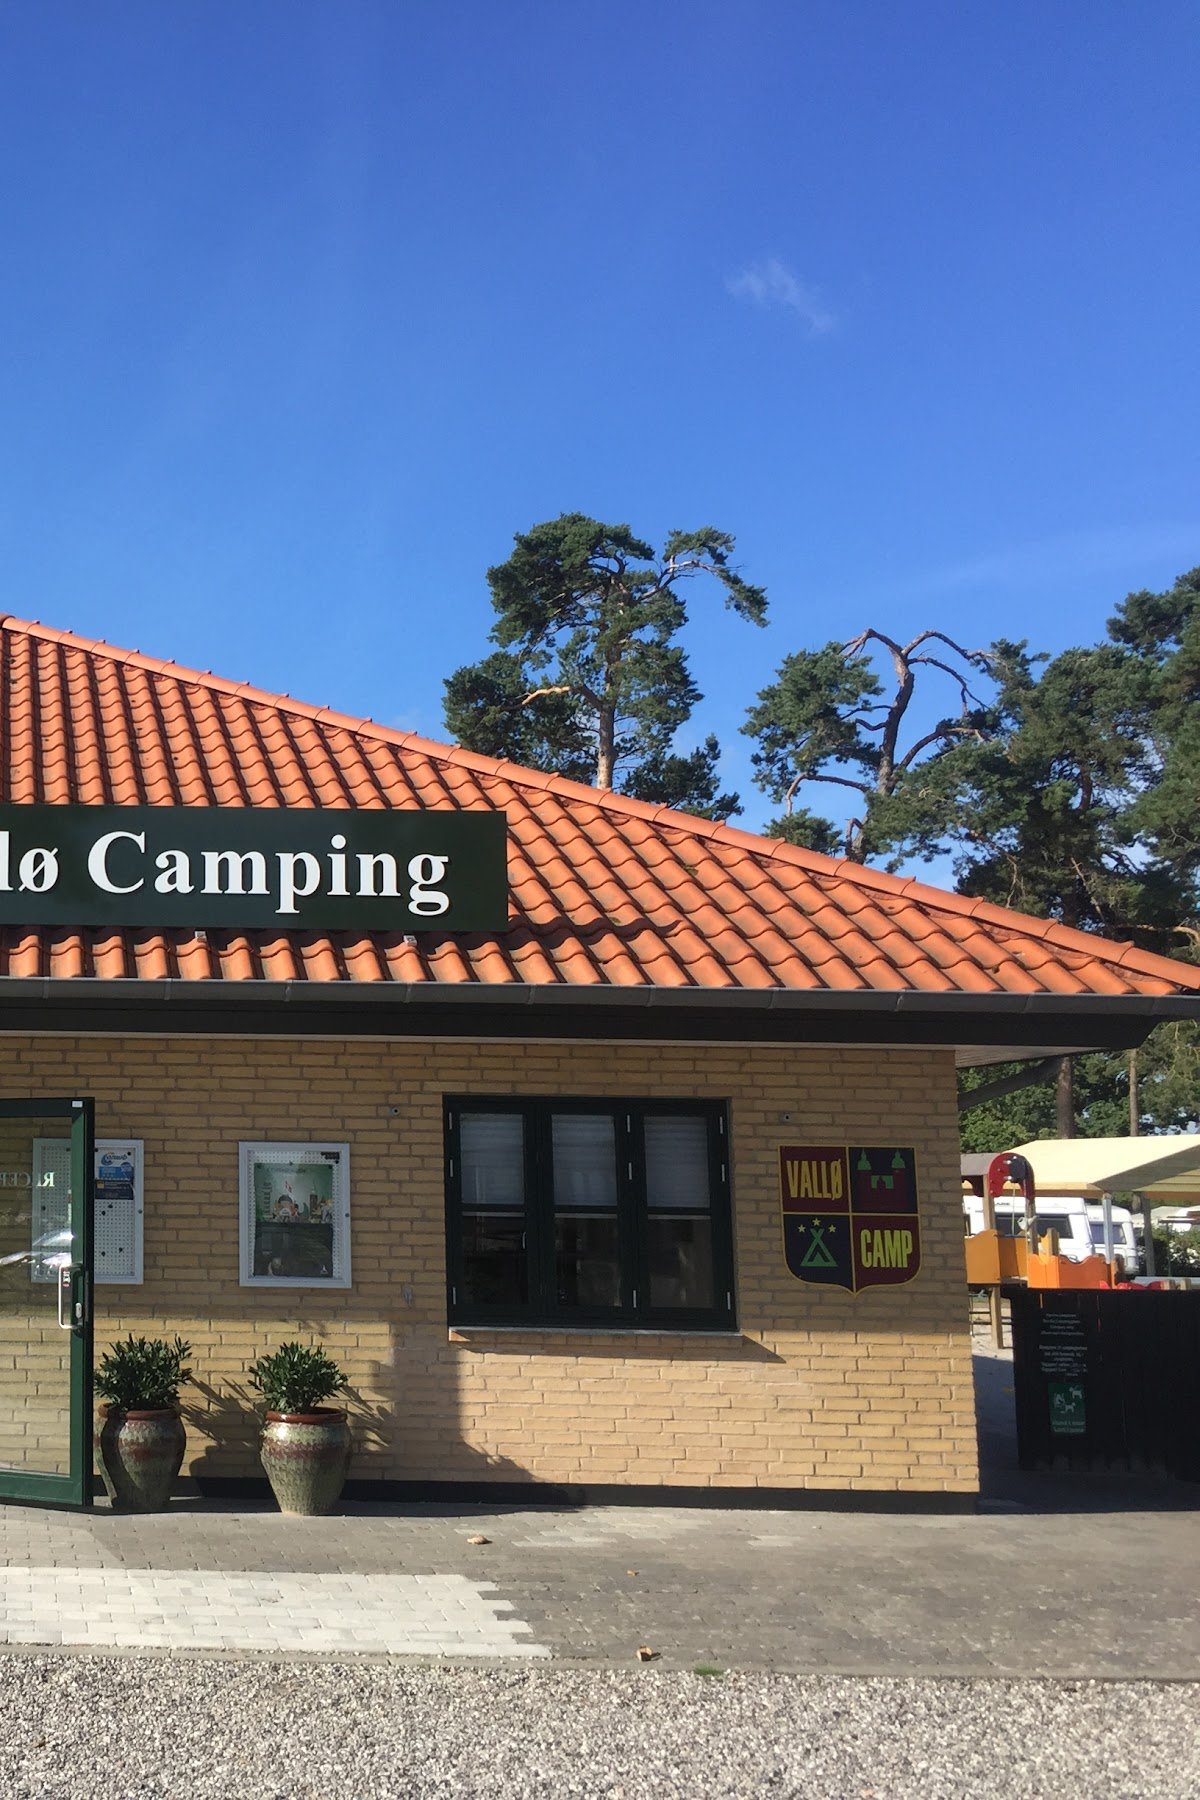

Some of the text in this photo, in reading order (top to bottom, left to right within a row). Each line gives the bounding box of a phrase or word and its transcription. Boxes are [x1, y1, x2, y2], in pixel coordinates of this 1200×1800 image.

[87, 831, 450, 916] Camping
[786, 1158, 842, 1201] VALLØ
[860, 1229, 913, 1268] CAMP
